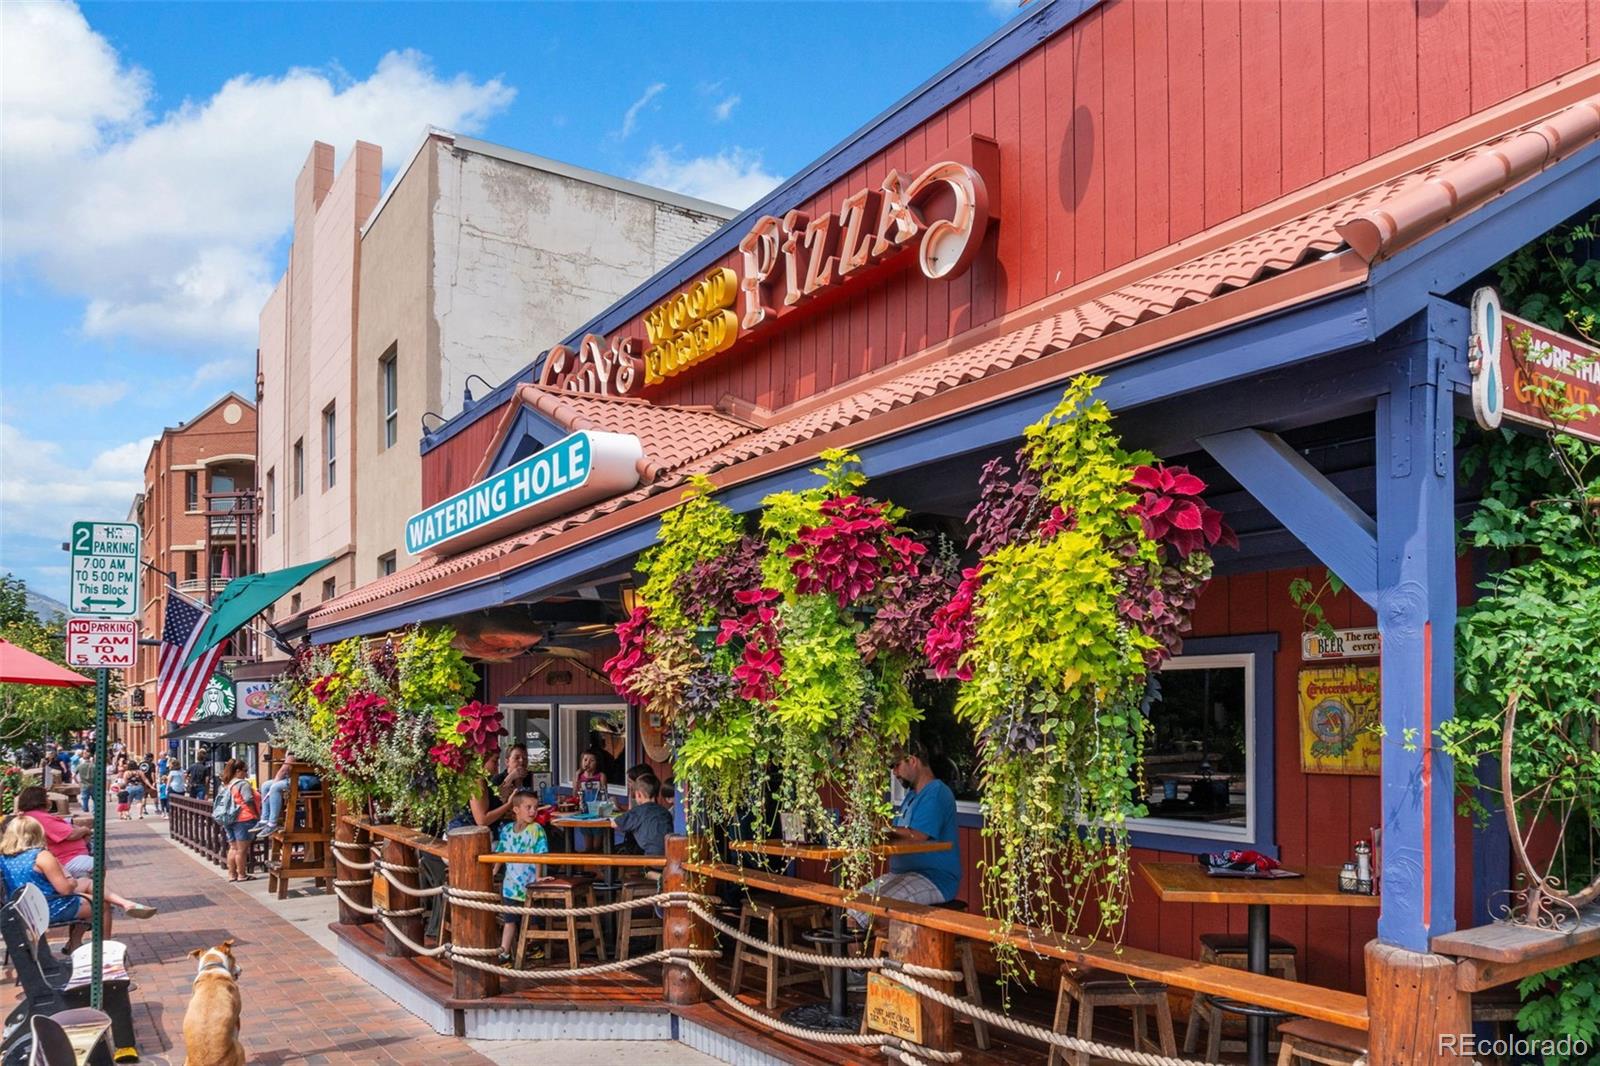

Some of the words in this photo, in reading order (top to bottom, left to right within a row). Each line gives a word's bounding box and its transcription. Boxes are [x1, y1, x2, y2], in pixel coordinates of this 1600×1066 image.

[645, 309, 737, 384] FIRED
[1525, 337, 1572, 370] MORE
[1513, 367, 1592, 418] GRAT
[409, 479, 508, 549] WATERING
[513, 440, 585, 504] HOLE
[75, 527, 90, 551] 2
[94, 541, 135, 554] PARKING
[110, 559, 126, 570] AM
[75, 570, 89, 581] TO
[118, 571, 133, 583] PM
[79, 583, 99, 594] This
[102, 583, 129, 595] Block
[70, 622, 89, 632] NO
[91, 623, 132, 632] PARKING
[76, 636, 89, 644] 2
[98, 637, 129, 645] AM
[1318, 637, 1345, 654] BEER
[1344, 632, 1361, 641] The
[1363, 632, 1380, 641] rea
[92, 645, 114, 653] TO
[1352, 643, 1376, 653] every
[98, 655, 129, 663] AM
